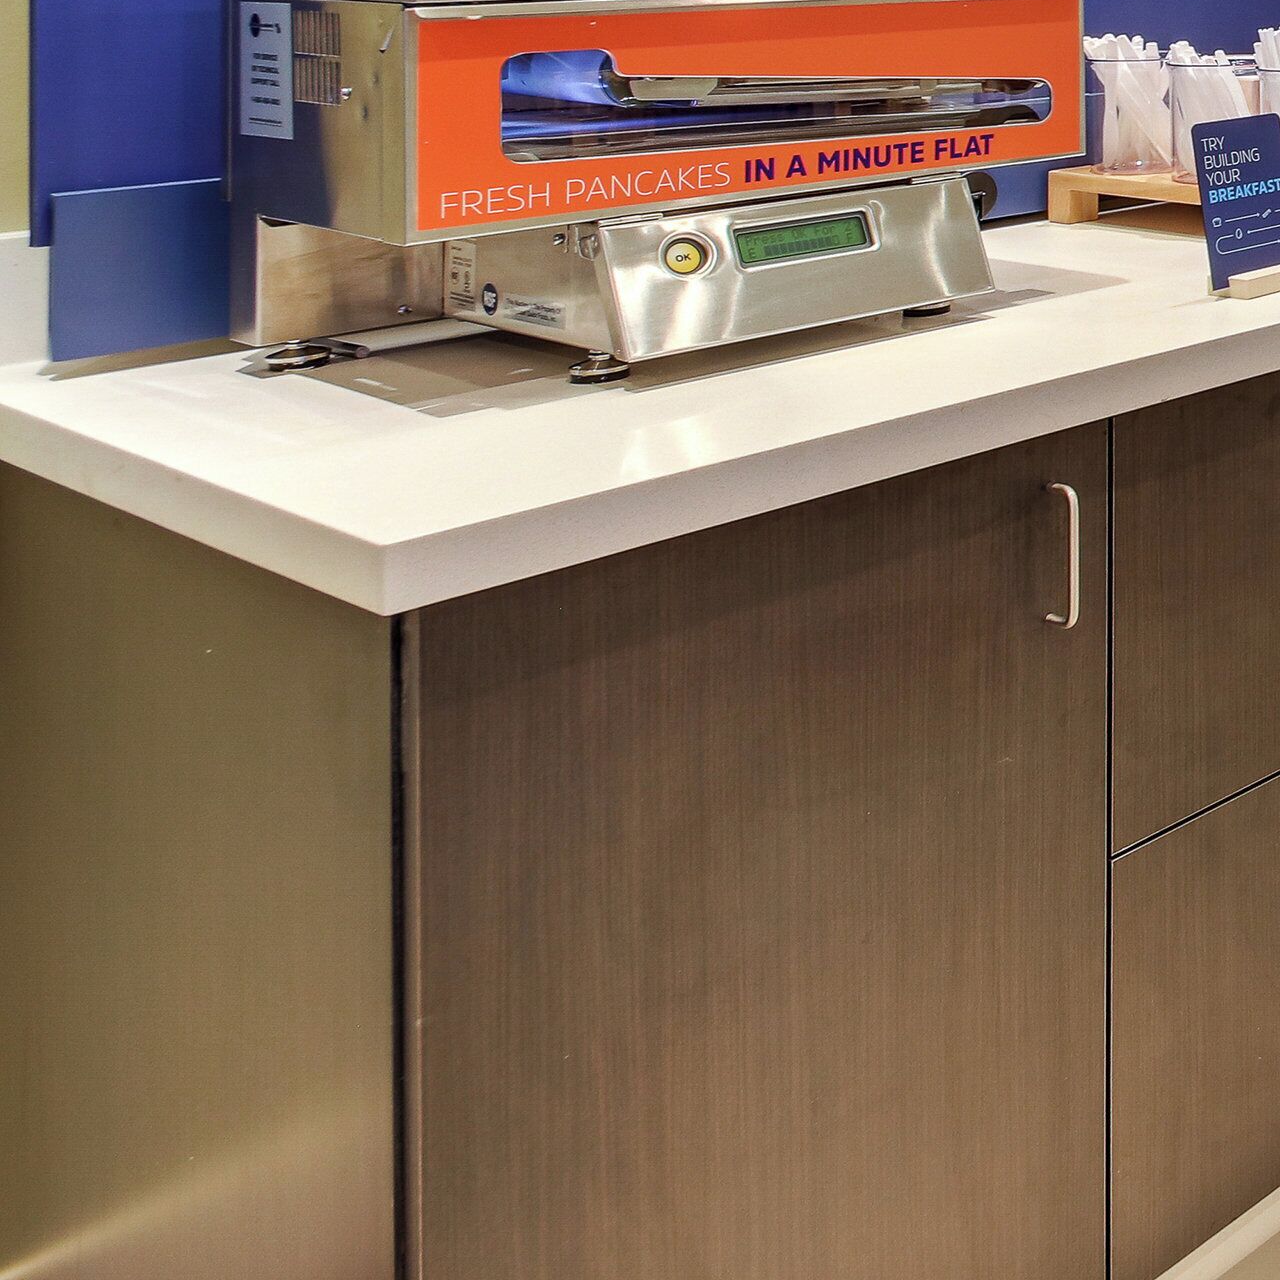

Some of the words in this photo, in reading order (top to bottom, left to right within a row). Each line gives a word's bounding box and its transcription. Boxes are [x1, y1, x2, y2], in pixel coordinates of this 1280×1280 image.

[1200, 136, 1225, 152] TRY
[1203, 147, 1261, 170] BUILDING
[439, 180, 552, 220] FRESH
[565, 161, 732, 206] PANCAKES
[743, 155, 775, 184] IN
[785, 153, 808, 179] A
[816, 141, 926, 176] MINUTE
[934, 133, 996, 162] FLAT
[1205, 168, 1241, 186] YOUR
[675, 252, 692, 263] OK
